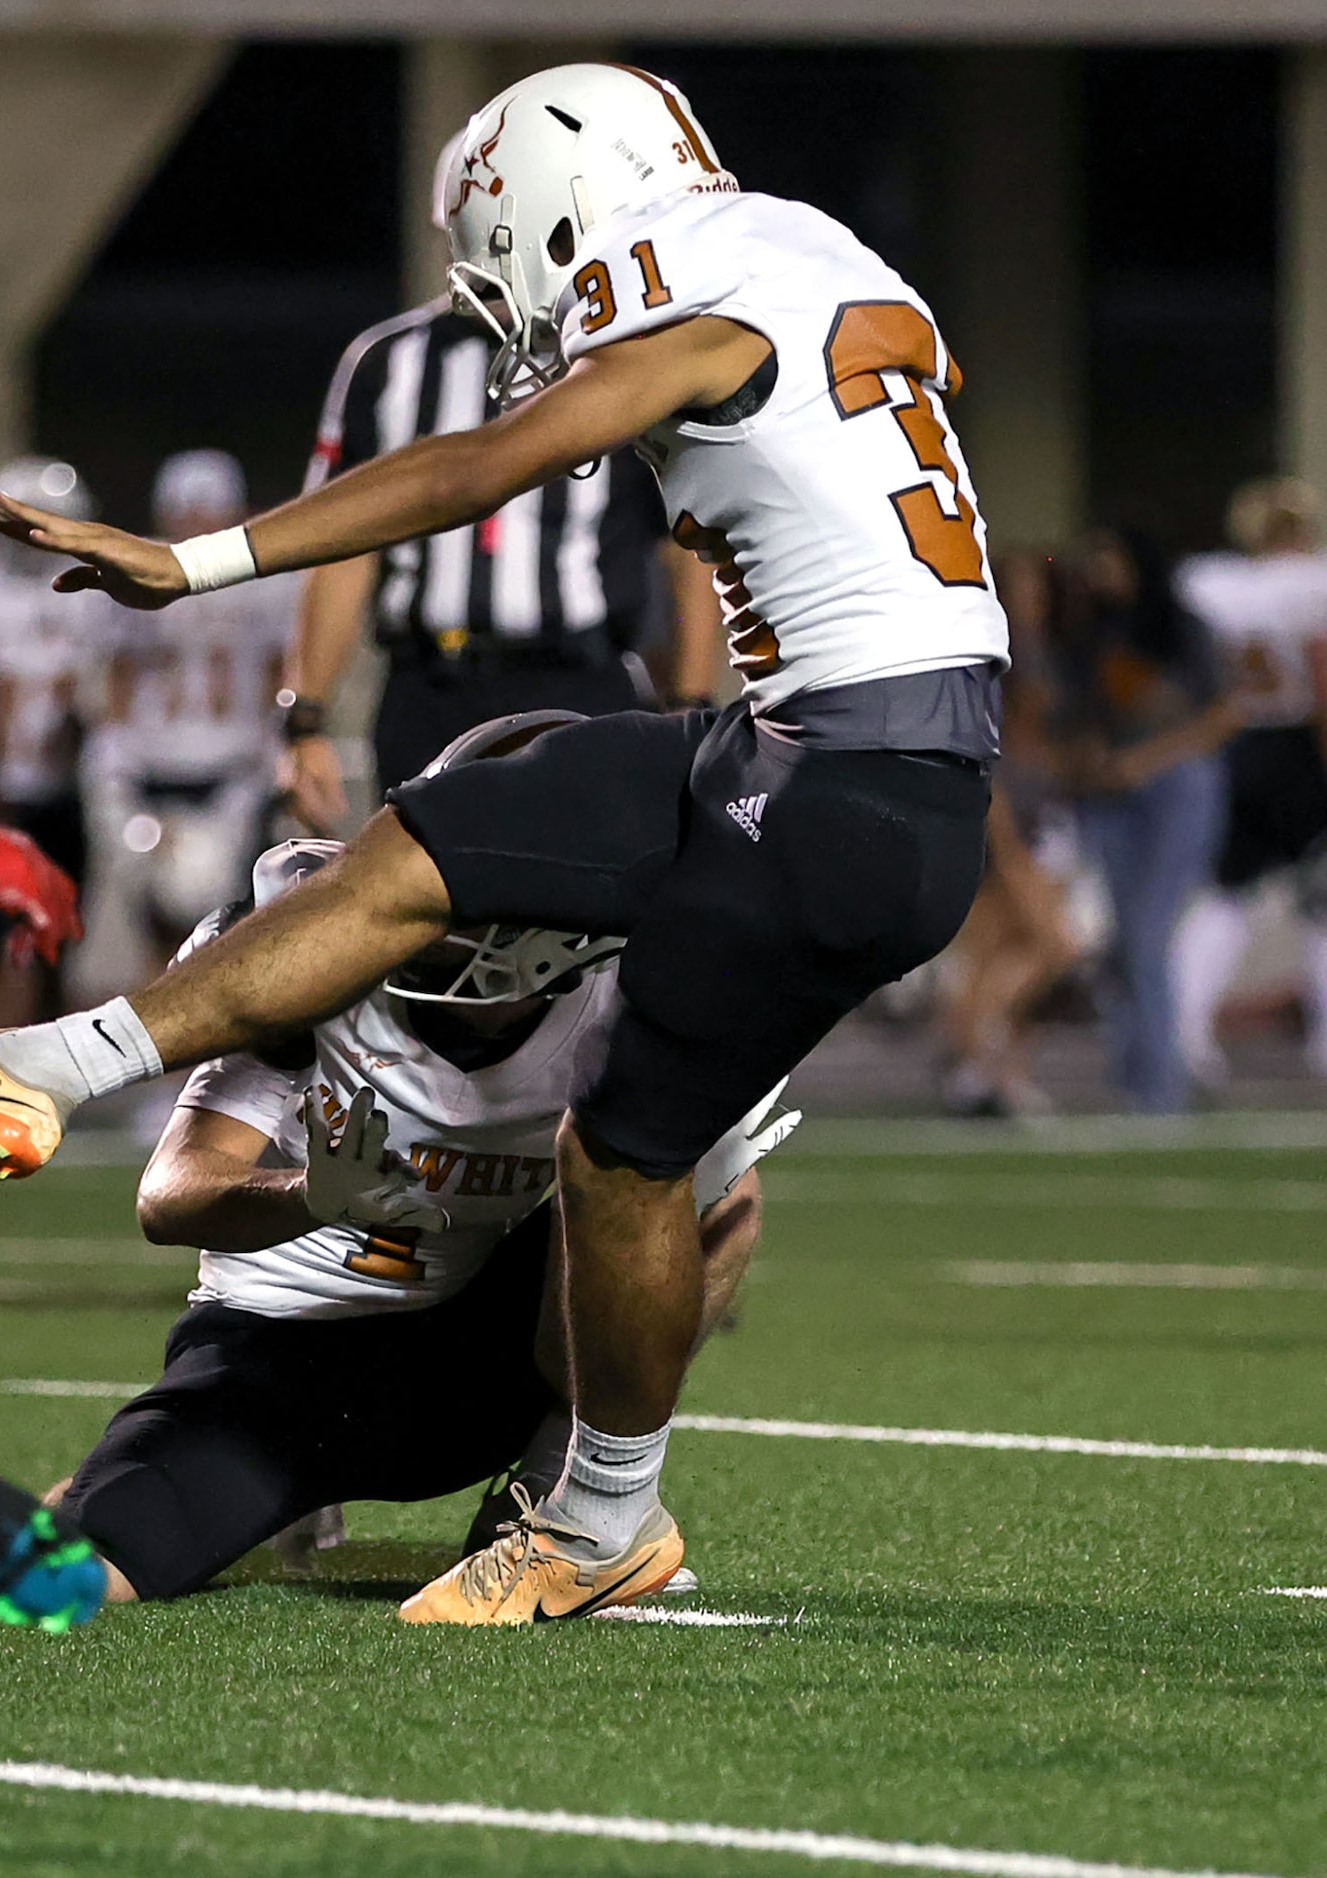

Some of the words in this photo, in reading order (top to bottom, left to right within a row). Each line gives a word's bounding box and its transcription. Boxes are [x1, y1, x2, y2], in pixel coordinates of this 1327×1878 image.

[671, 139, 696, 165] 31
[573, 239, 673, 335] 31
[822, 299, 990, 592] 3
[726, 801, 762, 843] adidas
[409, 1142, 556, 1196] WHIT
